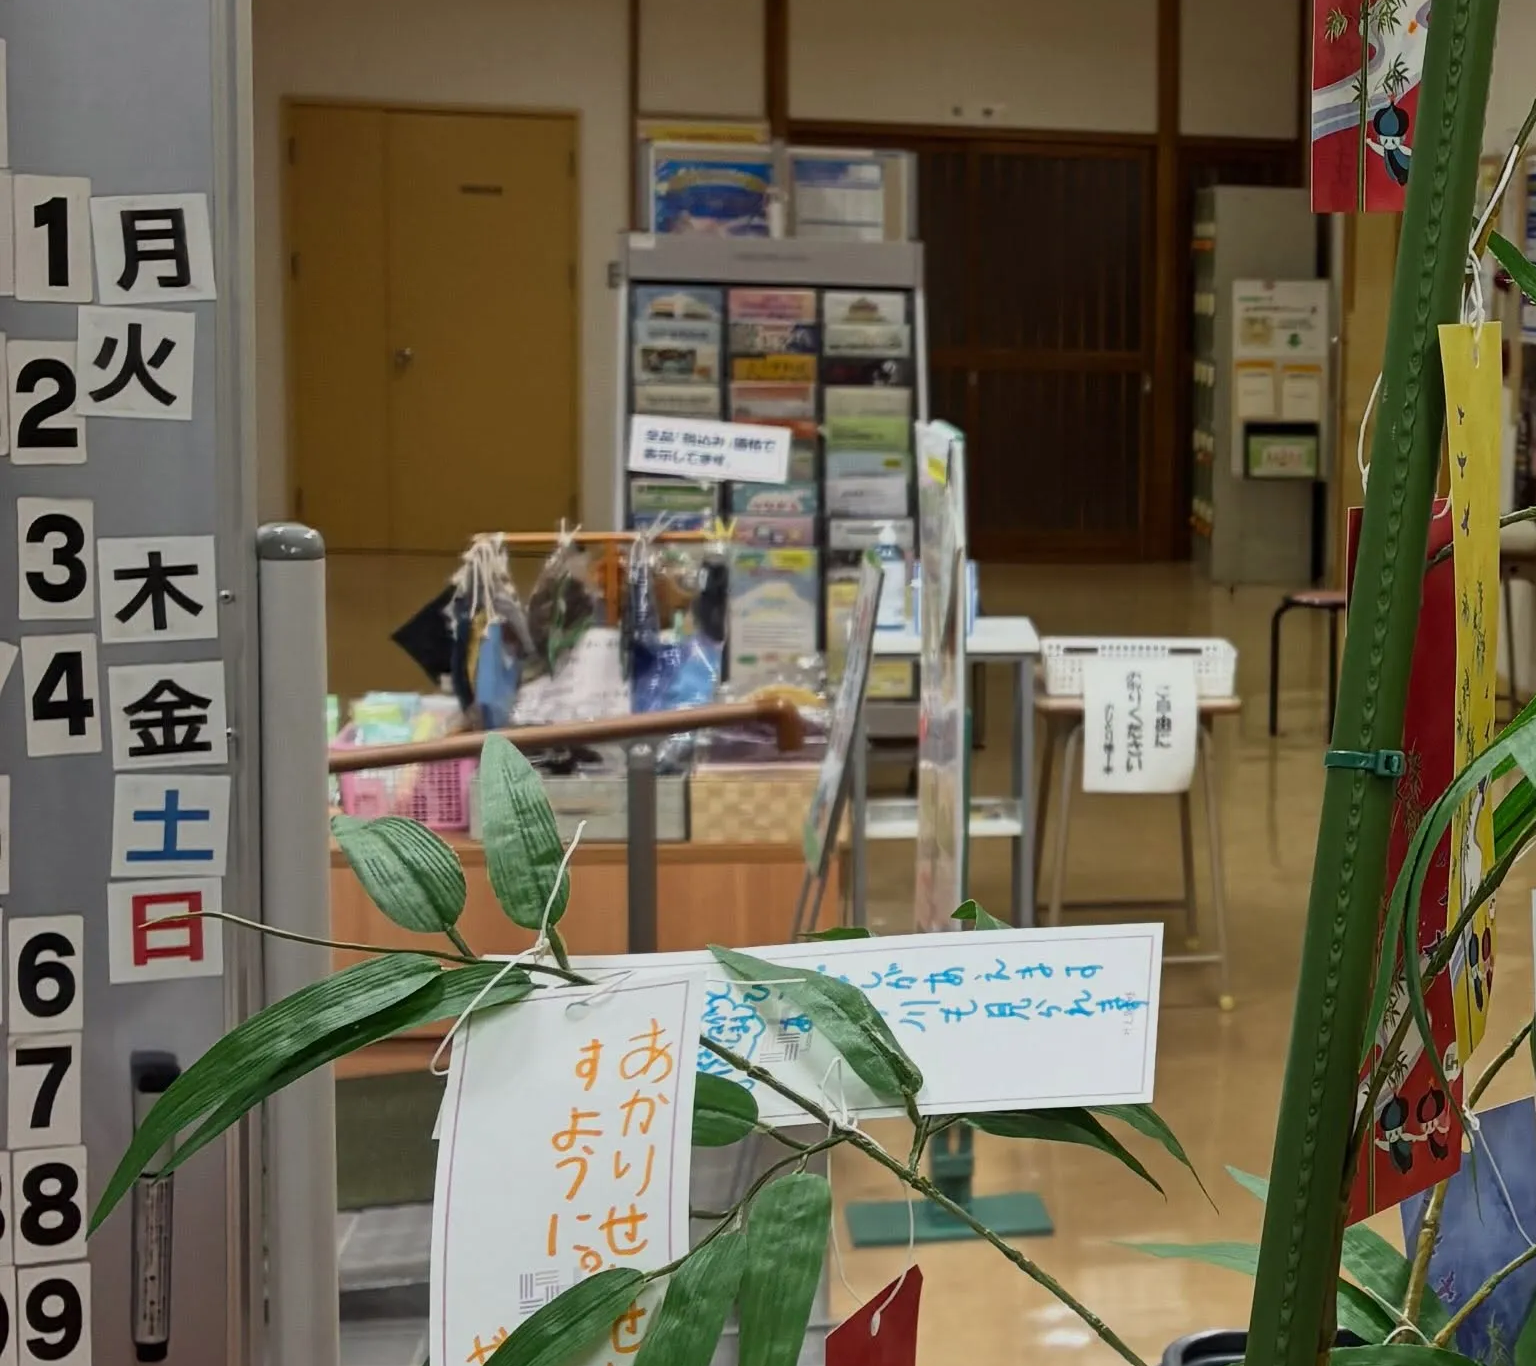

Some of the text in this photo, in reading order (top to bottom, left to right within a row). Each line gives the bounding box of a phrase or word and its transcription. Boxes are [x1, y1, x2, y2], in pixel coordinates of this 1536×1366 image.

[34, 197, 192, 291] 1 月
[14, 322, 178, 449] 2 火
[25, 514, 204, 631] 3 木
[31, 651, 214, 757] 4 金
[126, 788, 215, 863] 土
[132, 890, 204, 968] 日
[16, 931, 77, 1018] 6
[15, 1045, 73, 1129] 7
[20, 1162, 81, 1247] 8
[25, 1277, 84, 1361] 9
